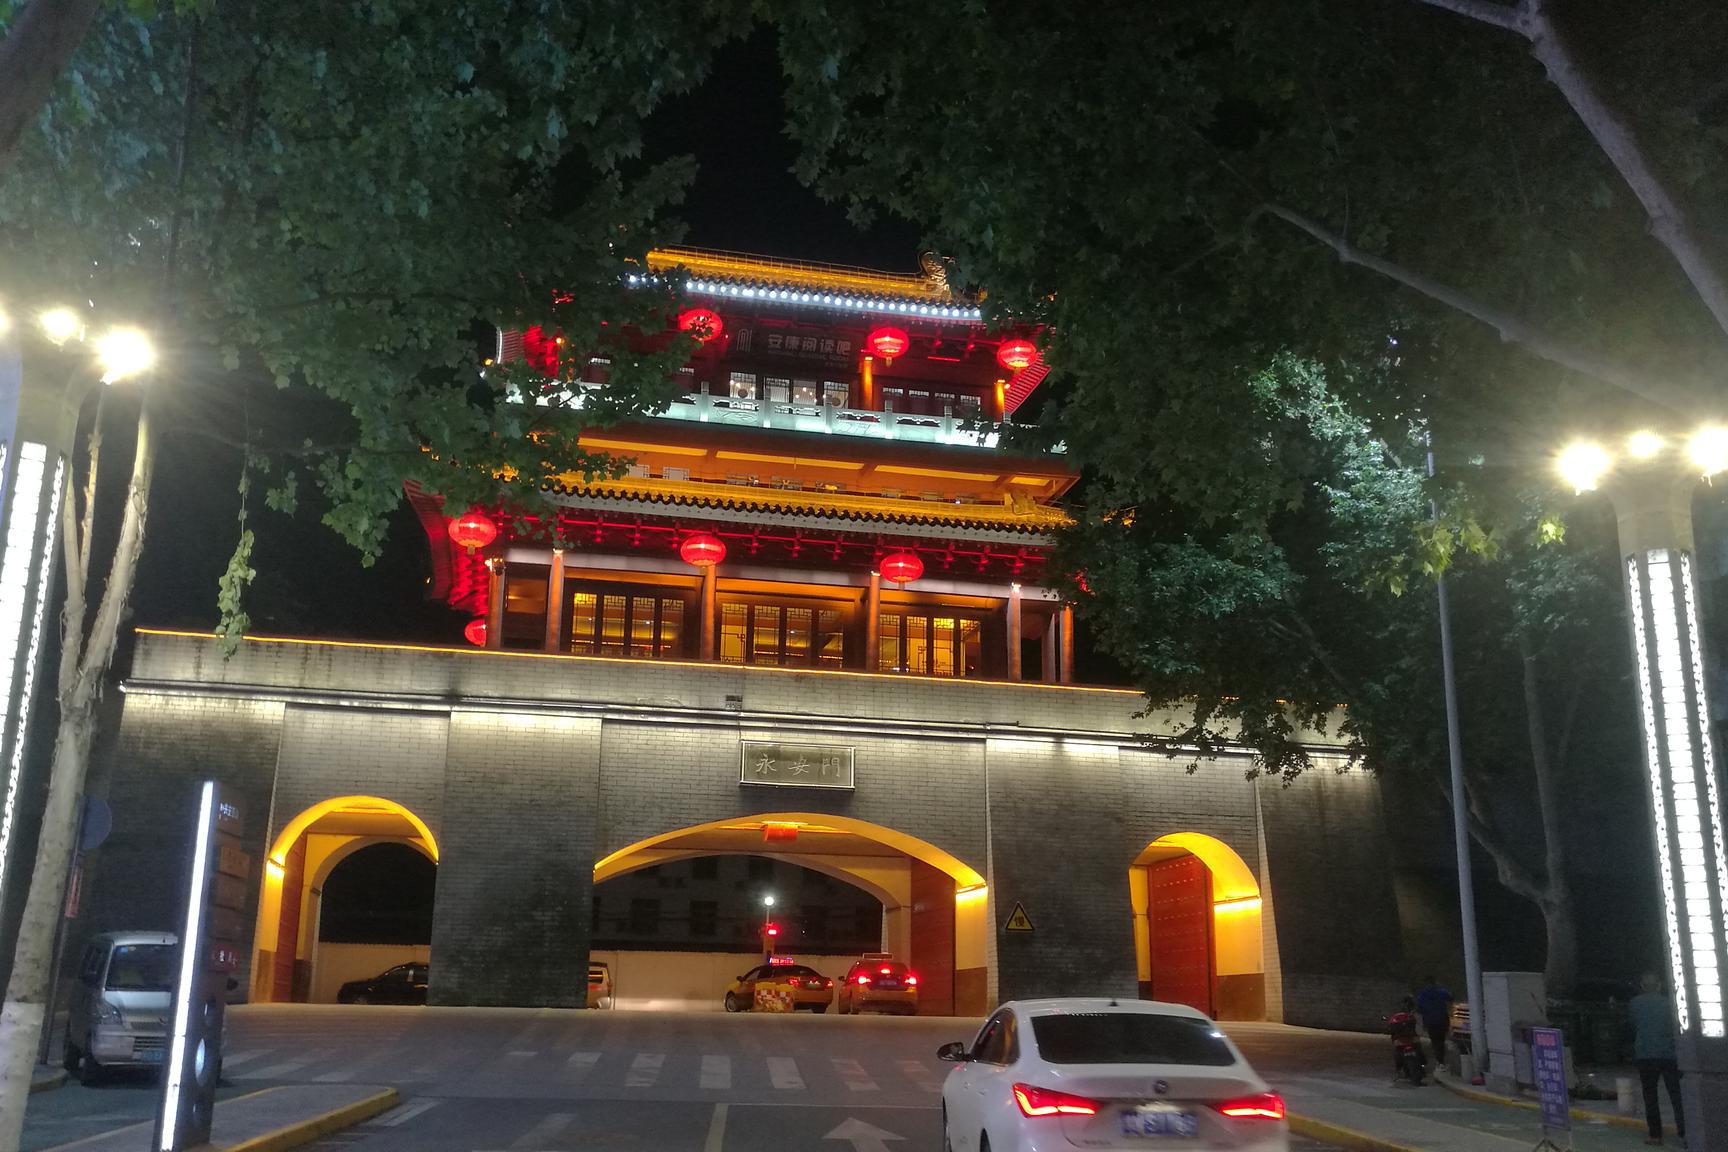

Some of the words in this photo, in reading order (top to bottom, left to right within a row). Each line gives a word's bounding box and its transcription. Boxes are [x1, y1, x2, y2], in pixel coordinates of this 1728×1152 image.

[768, 334, 851, 355] 安康阅读吧
[755, 753, 841, 777] 永安門
